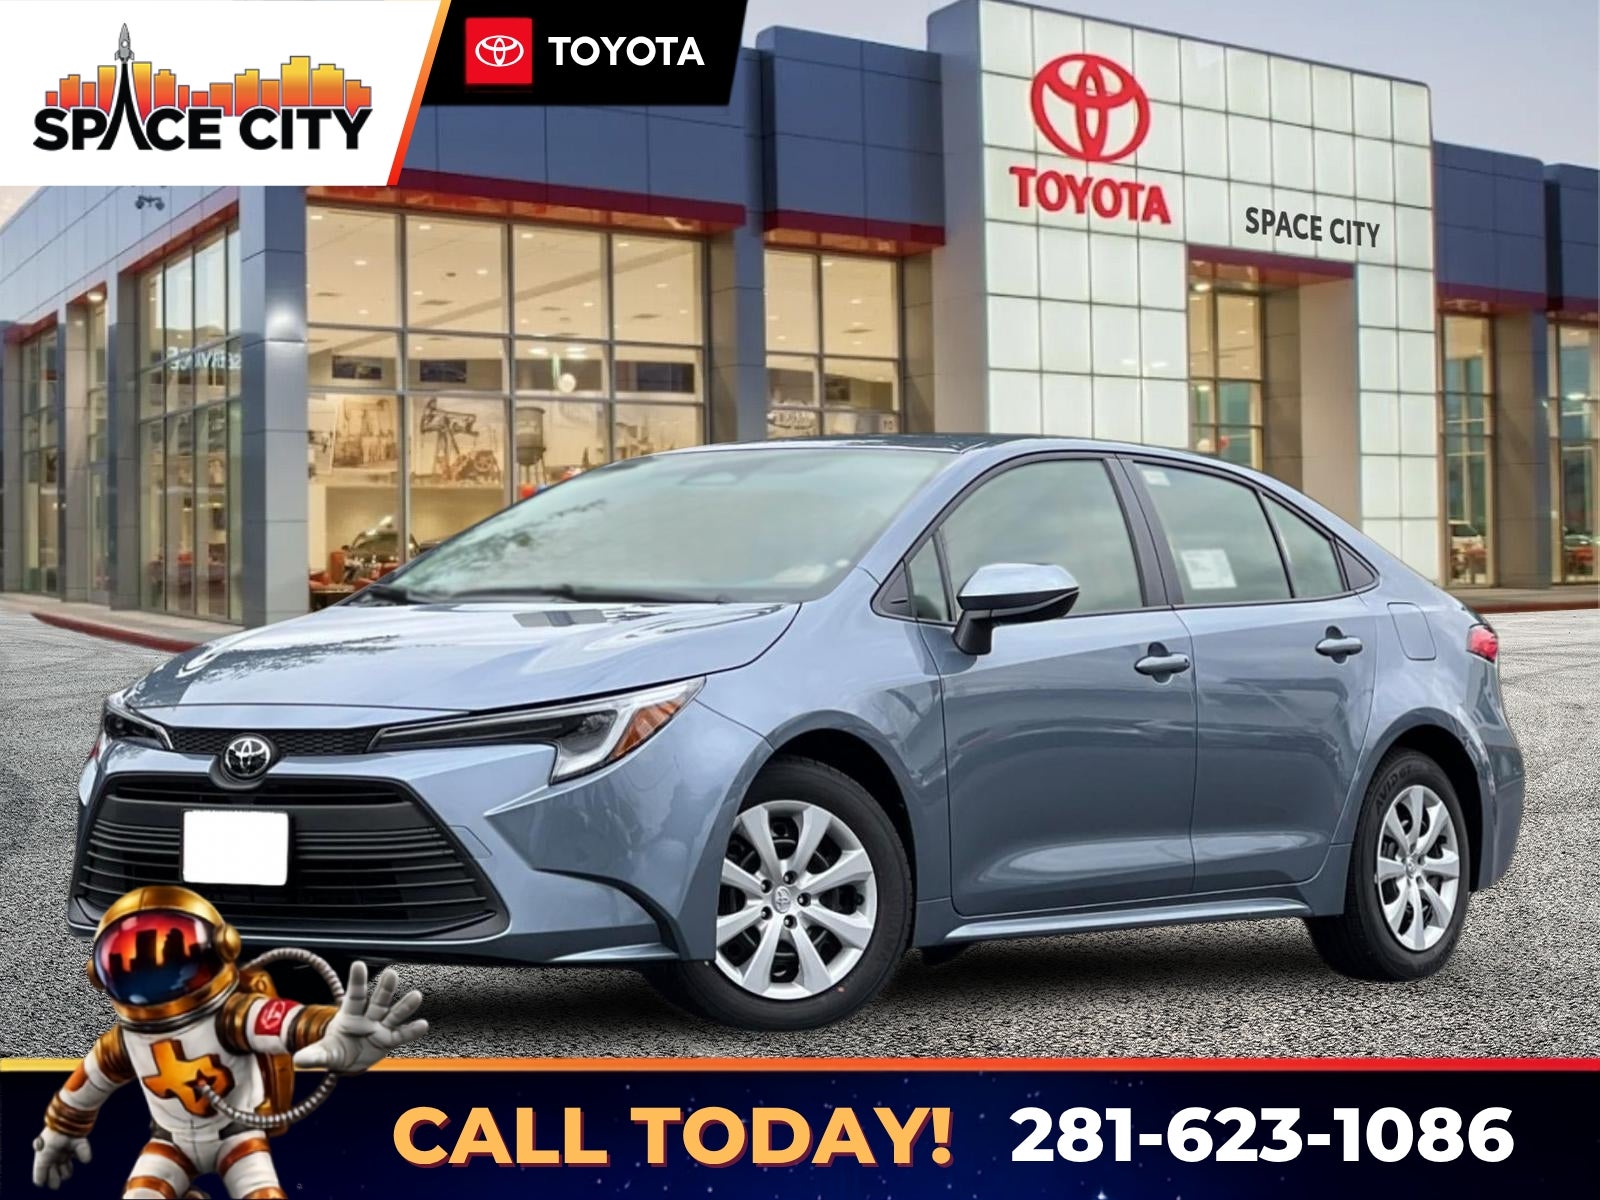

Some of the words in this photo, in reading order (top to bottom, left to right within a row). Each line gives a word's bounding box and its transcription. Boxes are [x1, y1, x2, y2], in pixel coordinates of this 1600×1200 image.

[1009, 166, 1172, 225] TOYOTA
[1245, 207, 1322, 242] SPACE
[1329, 218, 1381, 248] CITY
